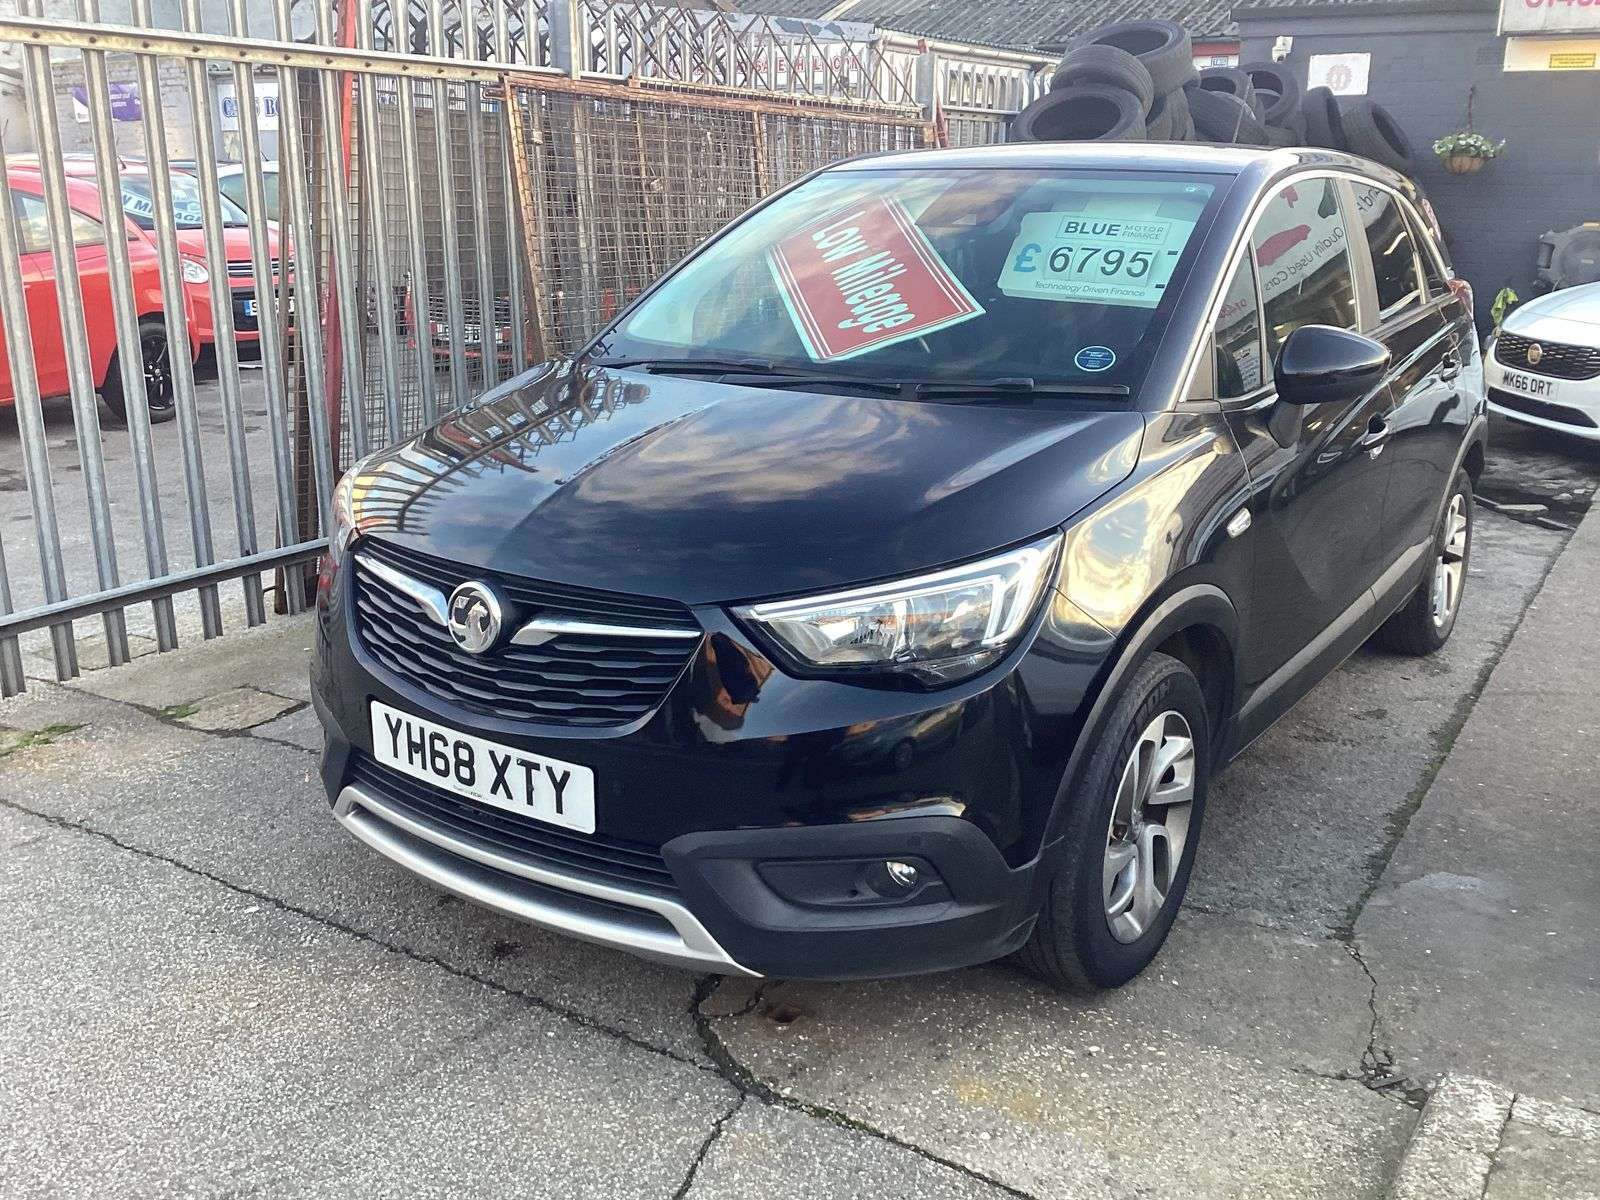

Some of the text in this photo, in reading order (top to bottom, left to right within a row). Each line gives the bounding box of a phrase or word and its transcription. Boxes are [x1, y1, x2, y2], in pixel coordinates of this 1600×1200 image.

[1064, 221, 1164, 237] BLUE MOTOR
[811, 210, 916, 334] Low Mileage
[1035, 281, 1146, 297] Technology Driven Finance
[1502, 370, 1529, 391] MK66
[384, 712, 571, 815] YH68 XTY
